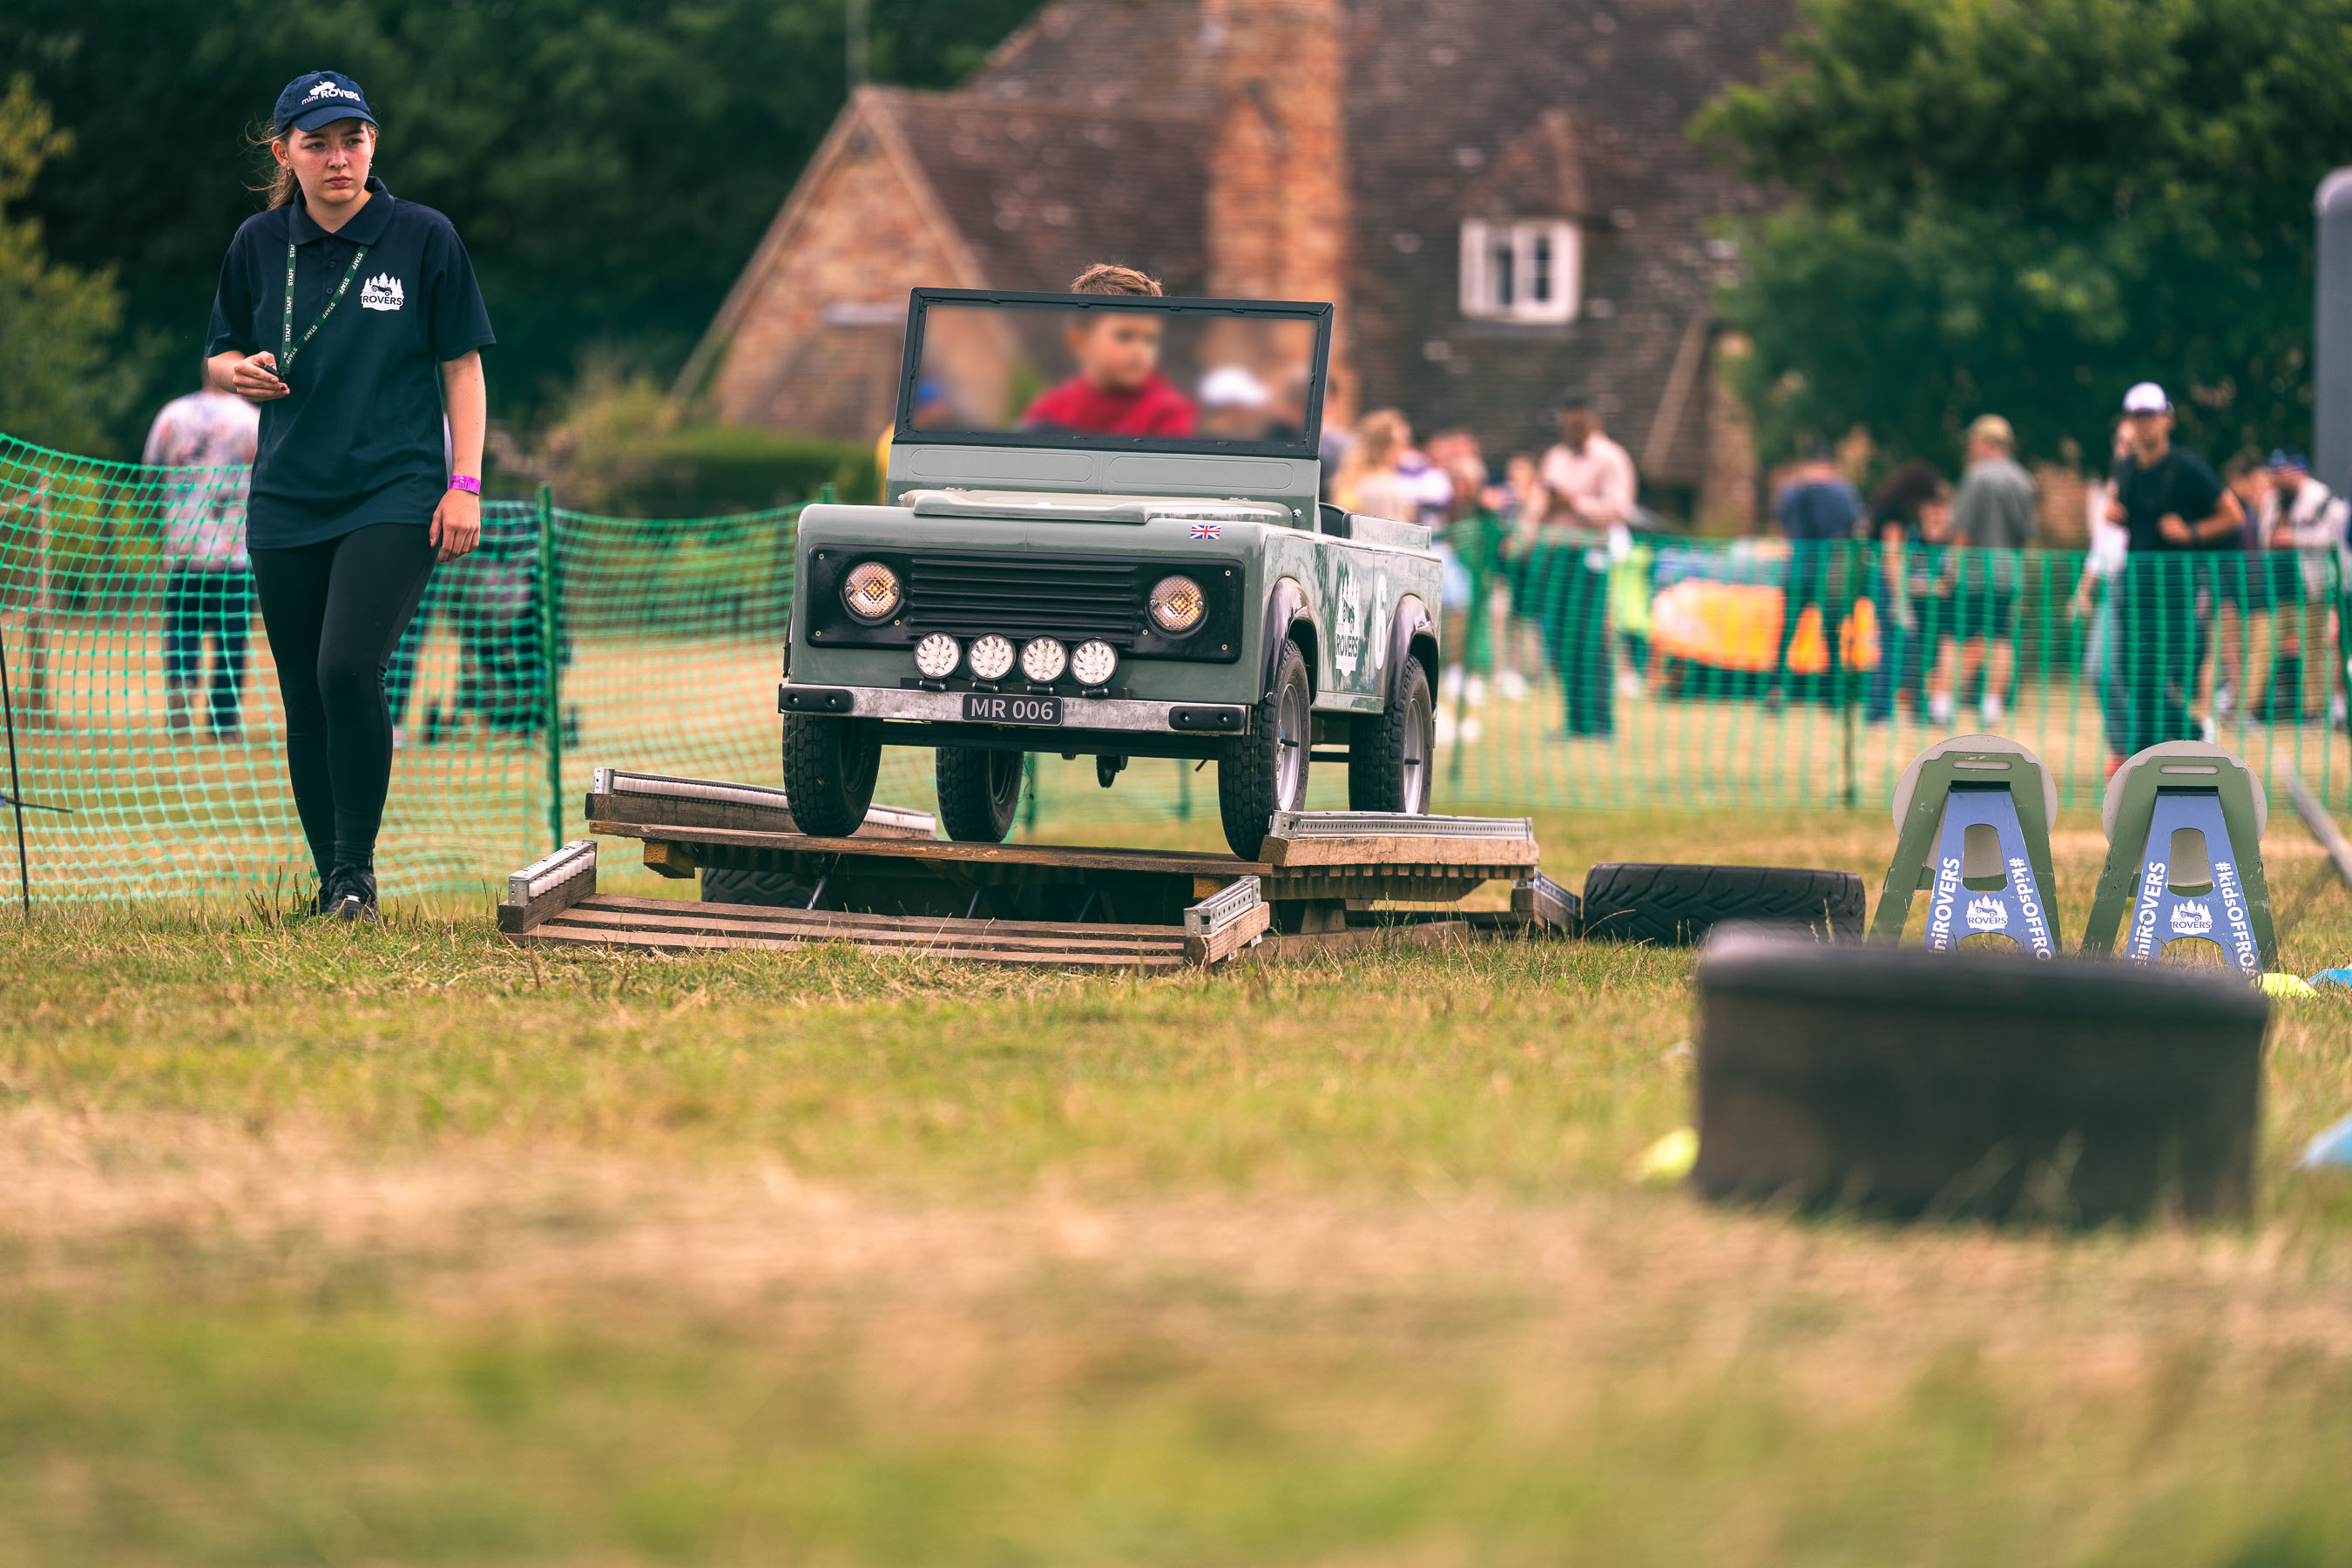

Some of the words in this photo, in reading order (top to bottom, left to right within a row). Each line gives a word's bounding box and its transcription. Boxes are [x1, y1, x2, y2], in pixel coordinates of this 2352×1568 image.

[321, 88, 361, 103] ROVERS
[352, 252, 363, 271] STAFF
[339, 277, 350, 295] STAFF
[362, 295, 402, 306] ROVERS
[322, 301, 336, 320] STAFF
[303, 324, 318, 341] STAFF
[285, 347, 298, 364] STAFF
[1375, 574, 1388, 670] 6
[1335, 633, 1359, 658] ROVERS
[970, 698, 1006, 719] MR
[1012, 700, 1054, 720] 006
[2009, 857, 2051, 962] #kidsOFFRO
[1968, 916, 2007, 925] ROVERS
[2173, 921, 2212, 929] ROVERS
